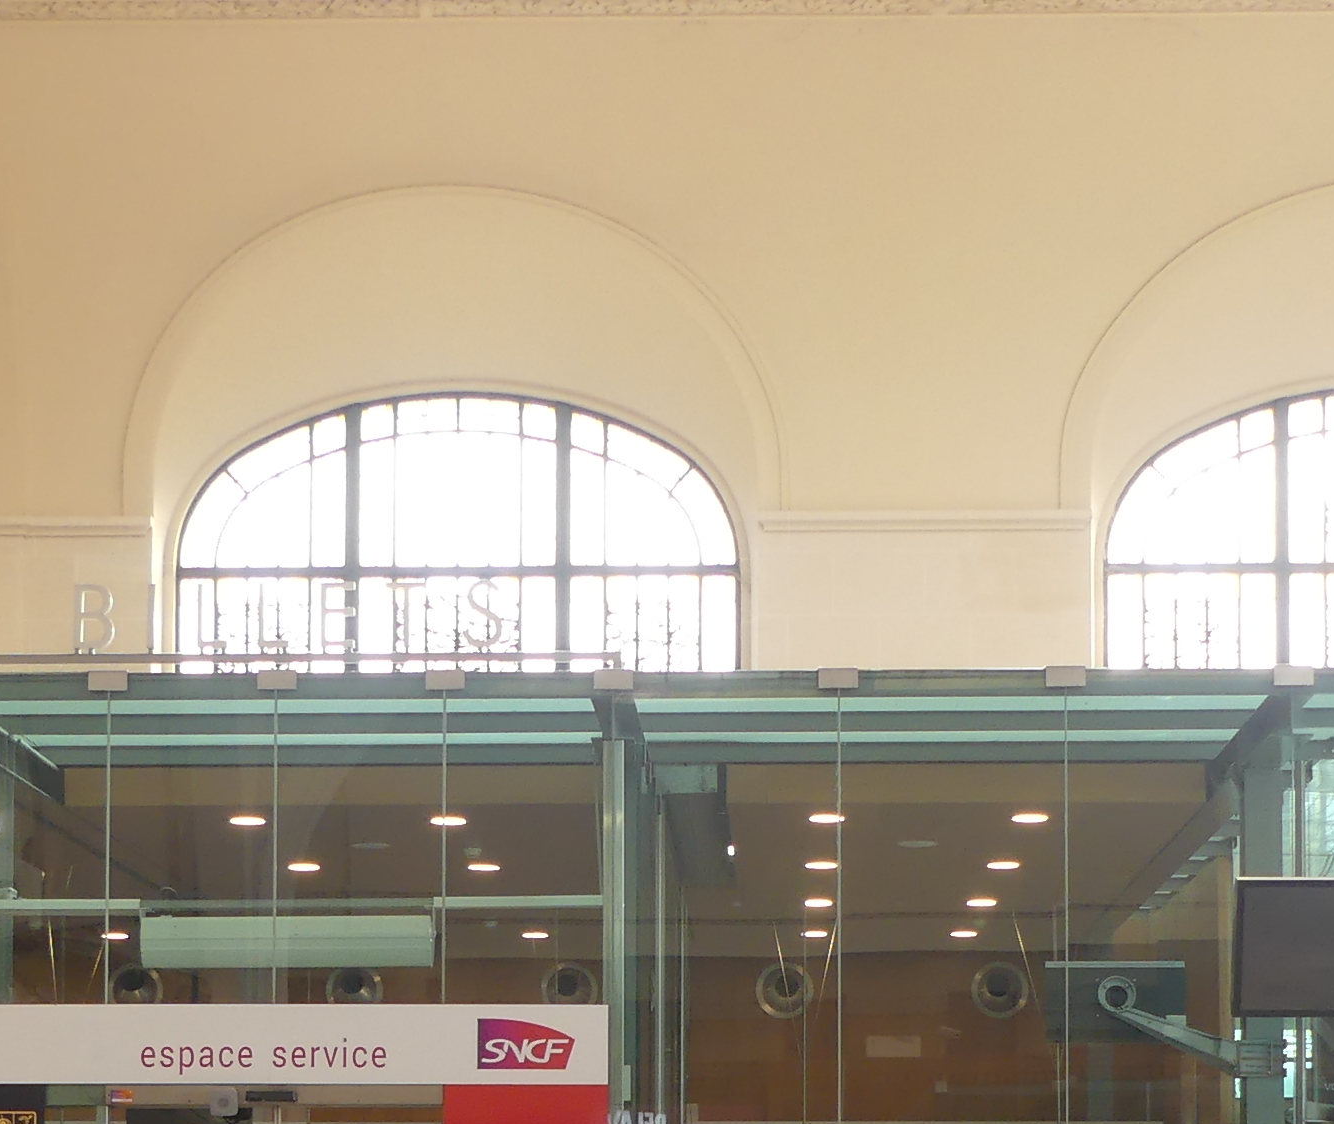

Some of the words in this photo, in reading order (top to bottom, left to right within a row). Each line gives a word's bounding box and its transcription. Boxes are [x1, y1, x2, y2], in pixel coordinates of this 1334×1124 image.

[75, 579, 503, 650] BILLETS
[140, 1044, 254, 1075] espace
[272, 1037, 387, 1069] service
[480, 1038, 571, 1064] SNCF
